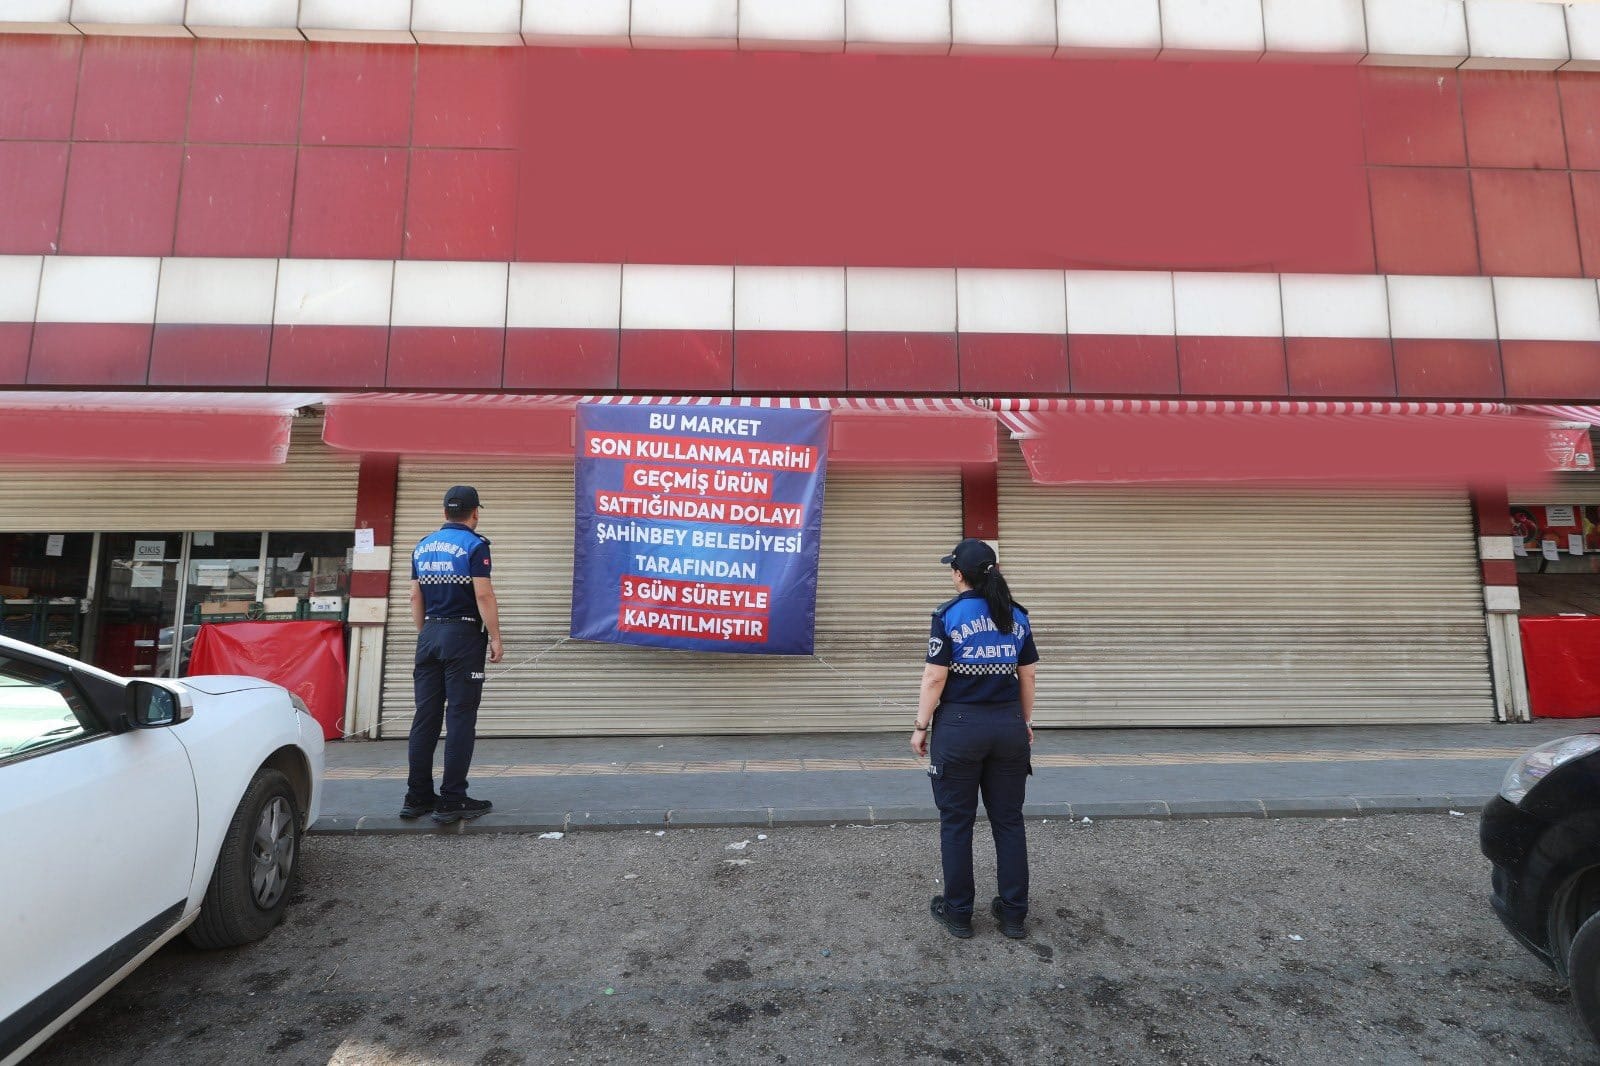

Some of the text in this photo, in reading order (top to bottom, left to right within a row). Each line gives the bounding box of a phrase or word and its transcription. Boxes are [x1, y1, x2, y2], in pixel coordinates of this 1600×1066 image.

[650, 413, 762, 436] BU MARKET
[590, 437, 810, 468] SON KULLANMA TARİHİ
[633, 468, 768, 495] GEÇMİŞ ÜRÜN
[599, 494, 801, 525] SATTIĞINDAN DOLAYI
[597, 521, 802, 553] ŞAHİNBEY BELEDİYESİ
[635, 554, 756, 579] TARAFINDAN
[623, 580, 767, 609] 3 GÜN SÜREYLE
[624, 609, 763, 640] KAPATILMIŞTIR
[962, 645, 1017, 659] ZABITA
